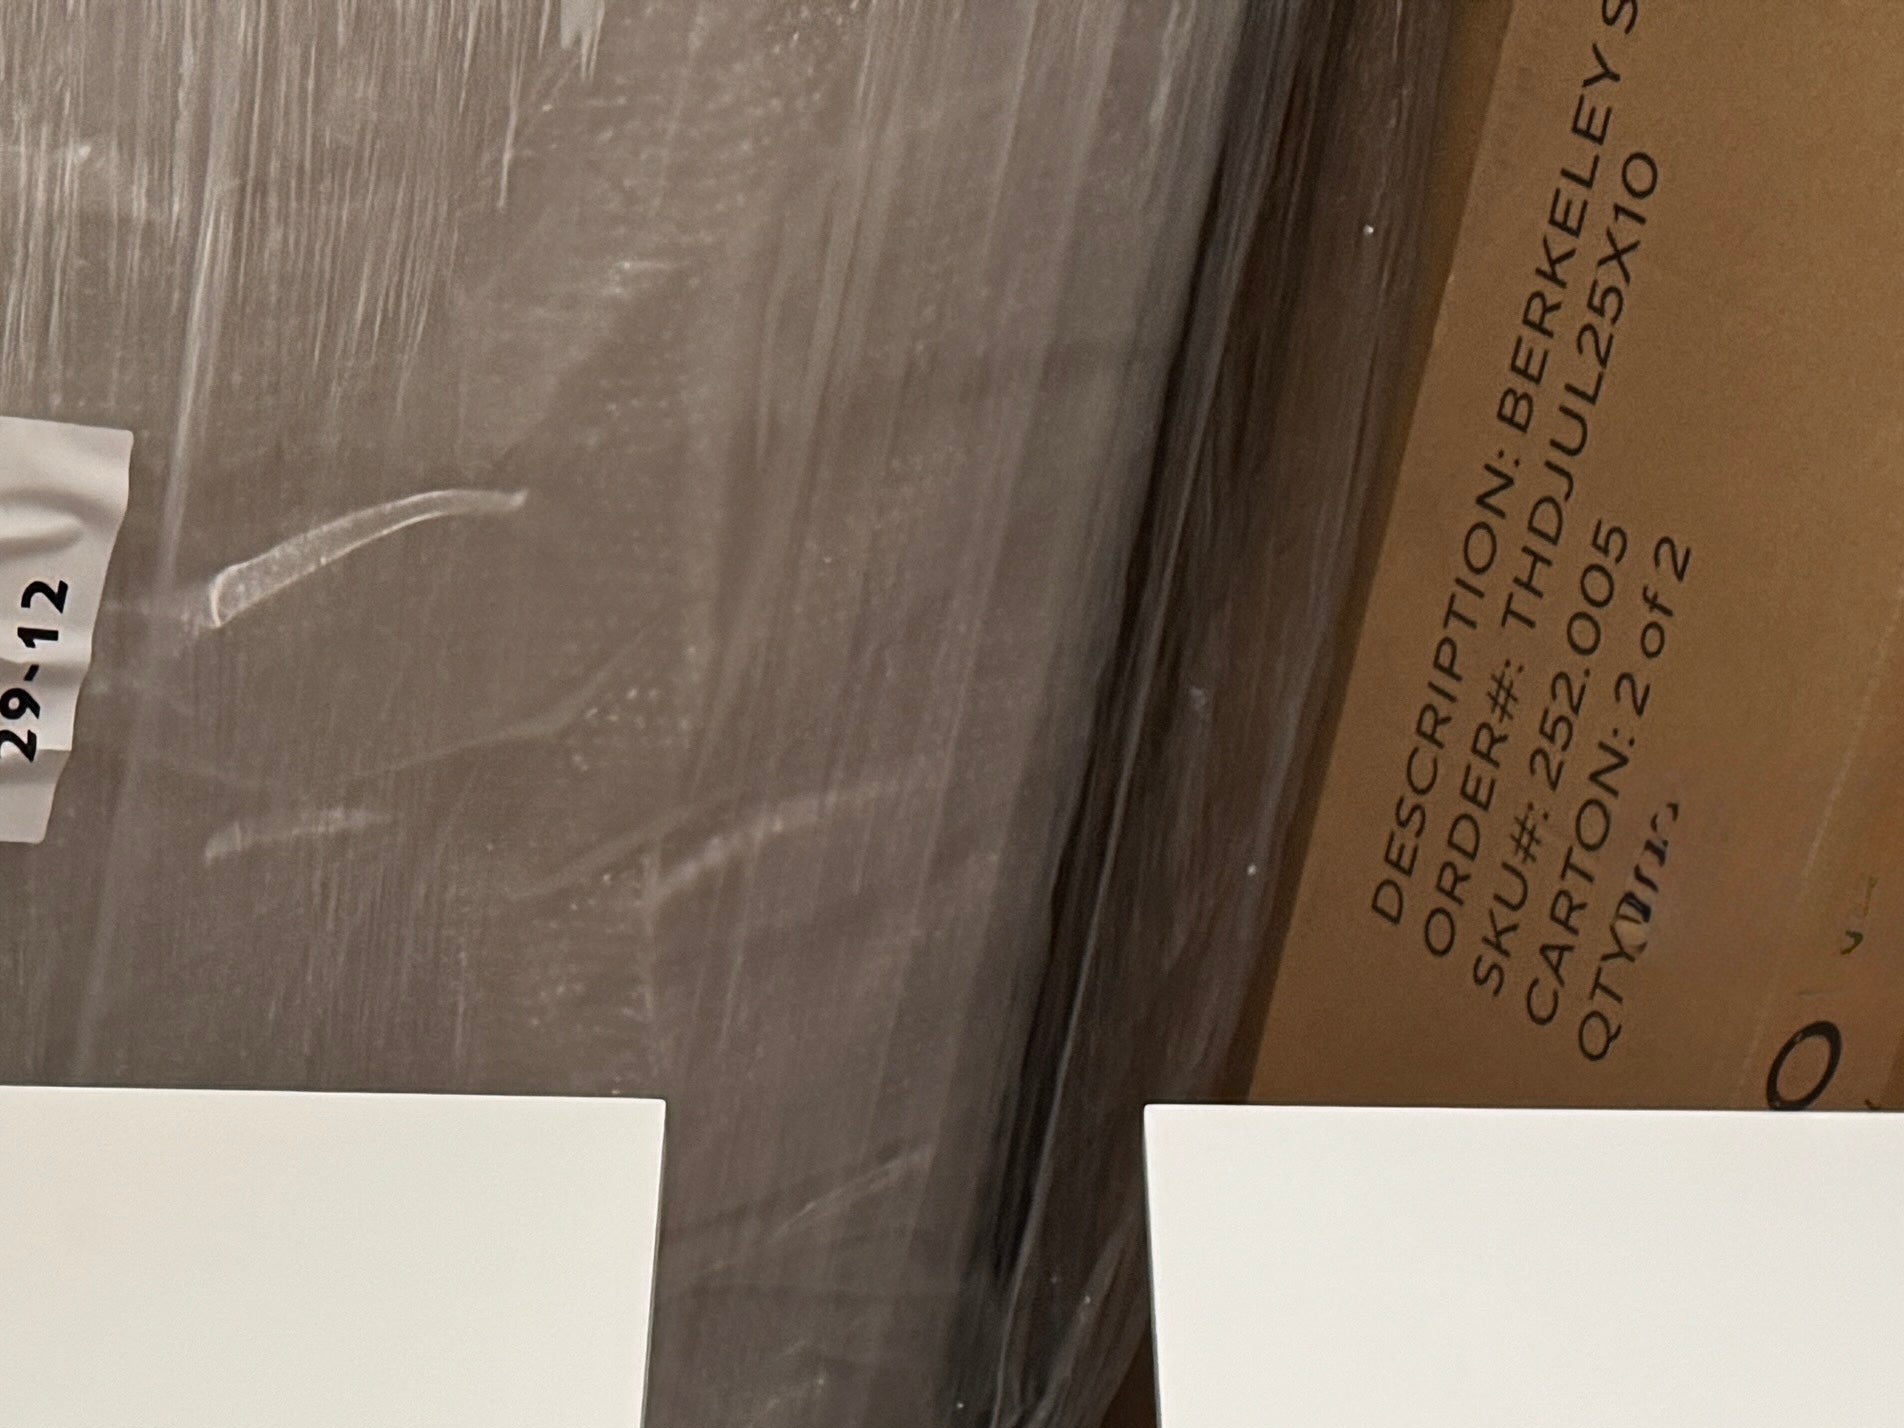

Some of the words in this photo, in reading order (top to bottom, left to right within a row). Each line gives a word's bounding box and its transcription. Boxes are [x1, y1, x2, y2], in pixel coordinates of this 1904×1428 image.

[1371, 447, 1521, 925] DESCRIPTION:
[1496, 42, 1621, 434] BERKELEY
[1423, 657, 1526, 959] ORDER#:
[1500, 150, 1659, 631] THDJUL25X10
[1640, 585, 1673, 659] of
[1653, 535, 1691, 582] 2
[1472, 800, 1549, 997] SKU#:
[1529, 518, 1629, 792] 252.005
[1614, 671, 1651, 716] 2
[1526, 726, 1636, 1026] CARTON:
